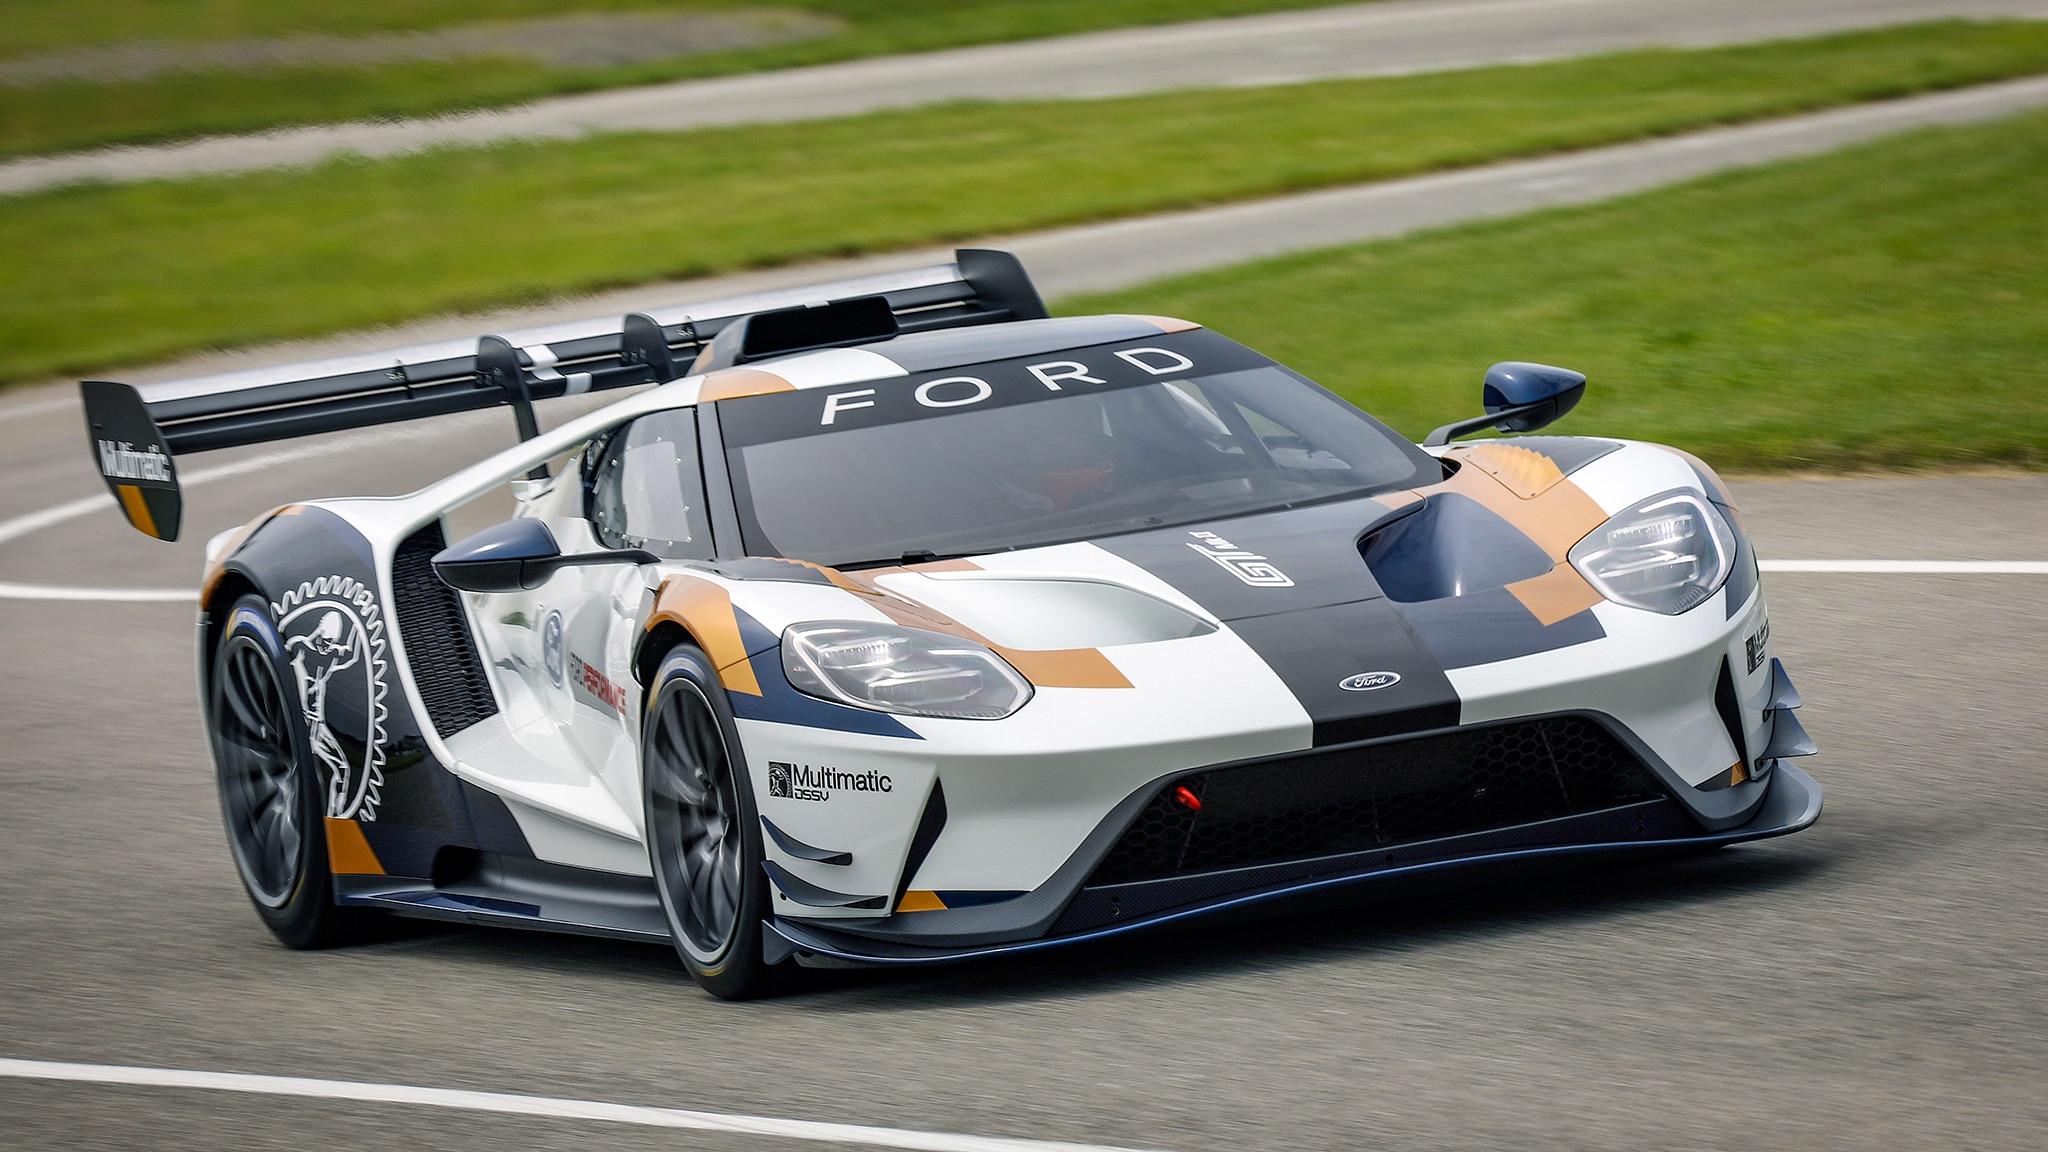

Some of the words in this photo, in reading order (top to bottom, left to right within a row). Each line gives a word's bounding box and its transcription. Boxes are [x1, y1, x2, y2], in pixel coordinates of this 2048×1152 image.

[820, 347, 1195, 426] FORD
[98, 439, 171, 482] Multimatic
[1354, 675, 1387, 688] Ford
[793, 763, 892, 793] Multimatic
[794, 788, 829, 801] DSSV
